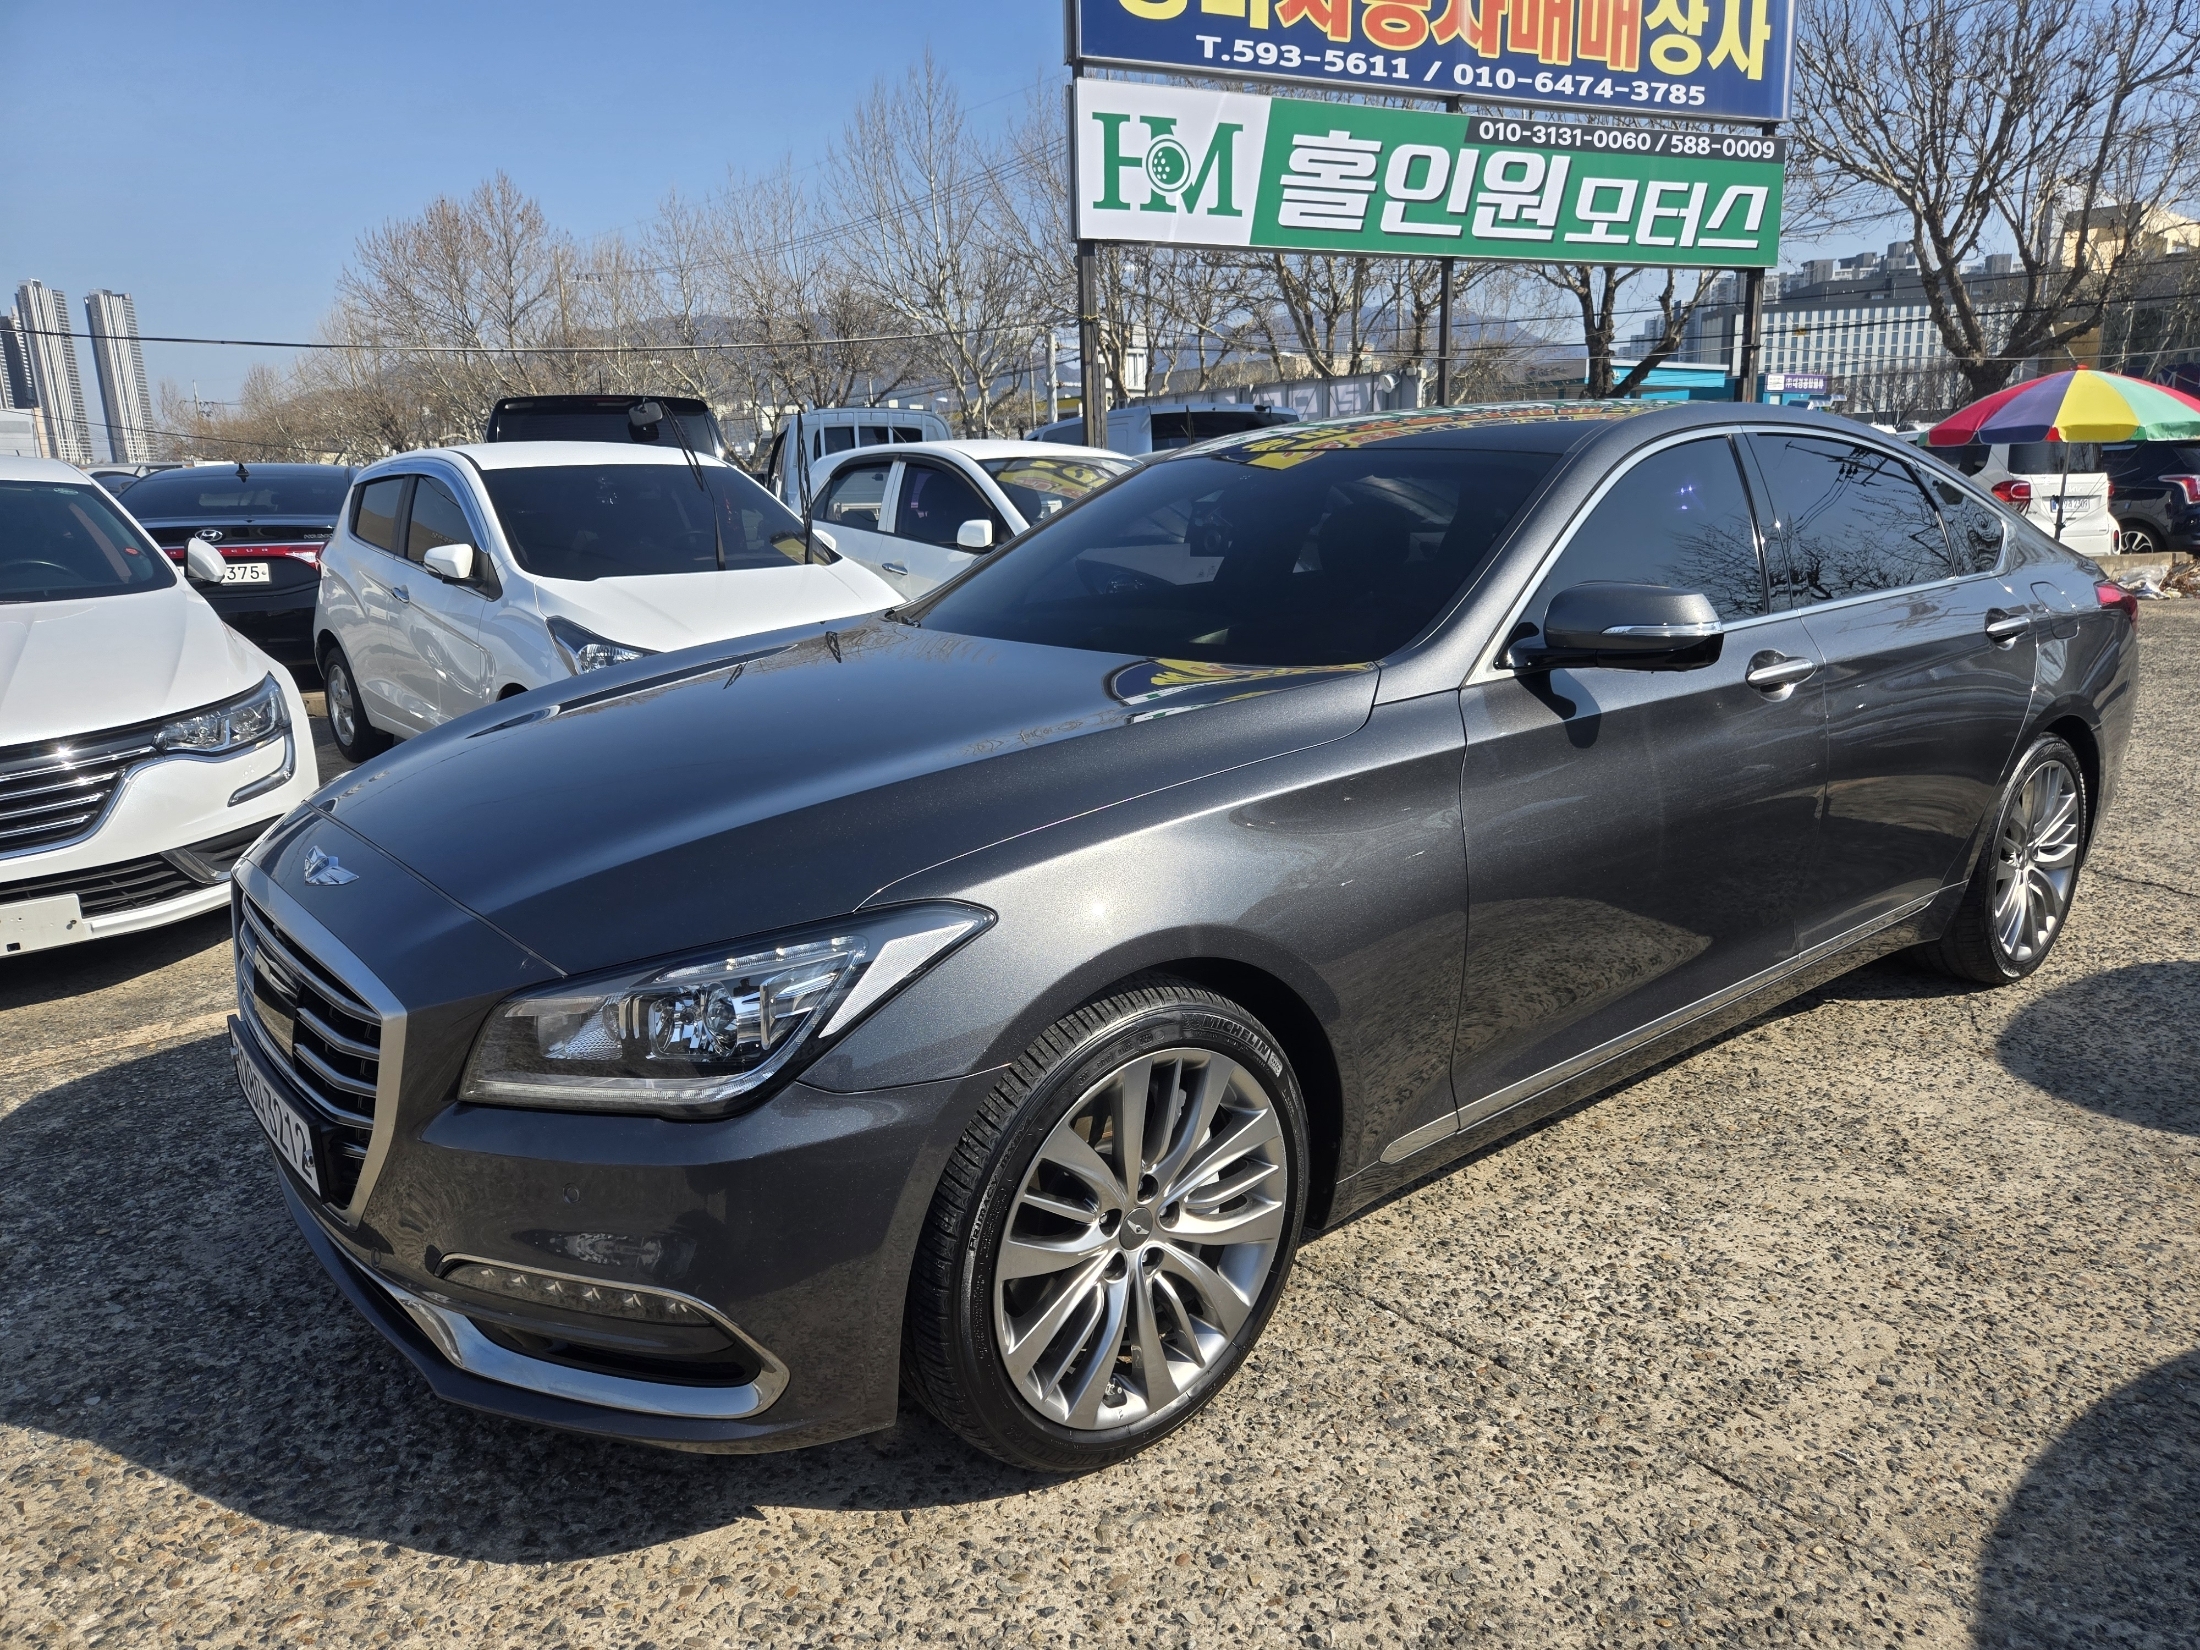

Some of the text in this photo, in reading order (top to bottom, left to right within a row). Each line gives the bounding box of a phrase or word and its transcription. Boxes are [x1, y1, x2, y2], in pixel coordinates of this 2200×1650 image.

[1196, 35, 1410, 80] T.593-5611
[1453, 63, 1706, 107] 010-6474-3785
[1479, 121, 1651, 151] 010-3131-0060
[1670, 135, 1776, 159] 588-0009
[1277, 129, 1770, 250] 홀인원 모터스
[222, 565, 260, 581] 375
[1200, 1014, 1272, 1063] MICHELIN
